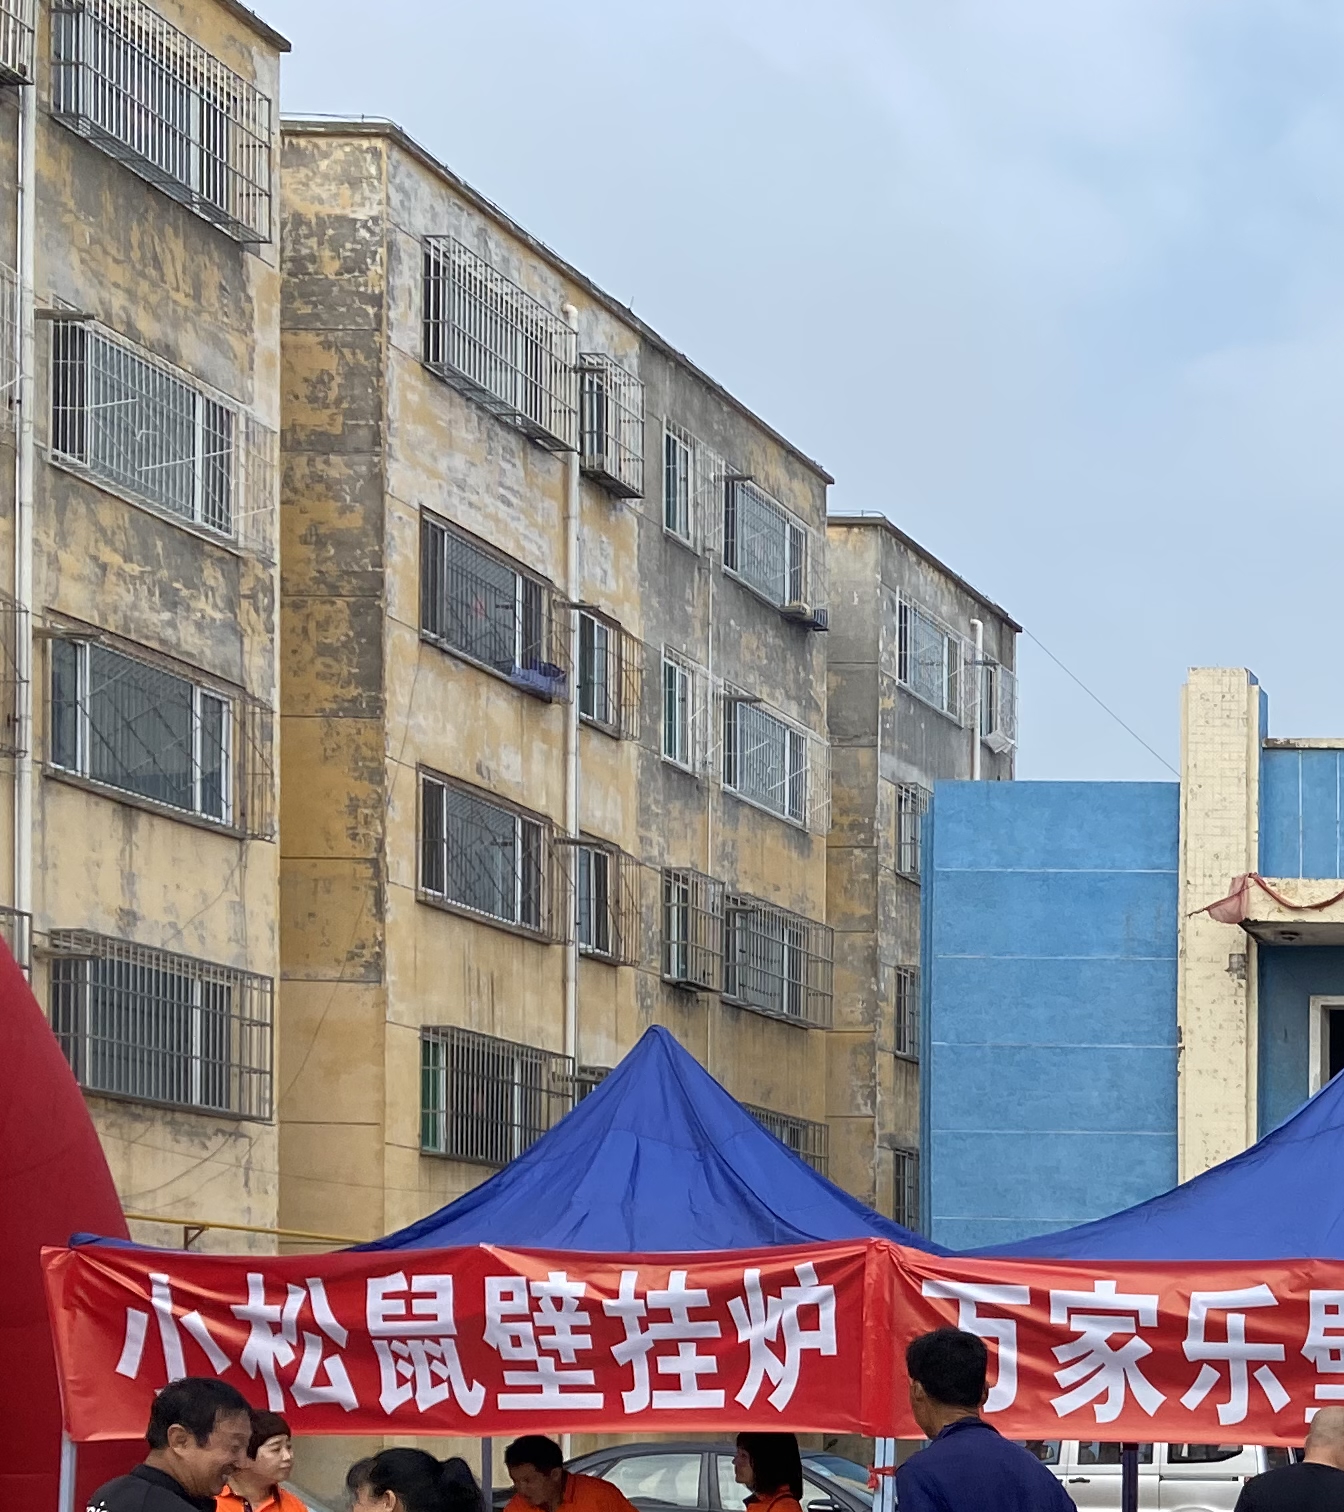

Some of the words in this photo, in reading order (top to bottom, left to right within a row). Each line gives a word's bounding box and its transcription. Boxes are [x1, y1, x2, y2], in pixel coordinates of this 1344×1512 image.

[115, 1260, 838, 1416] 小松鼠壁挂炉
